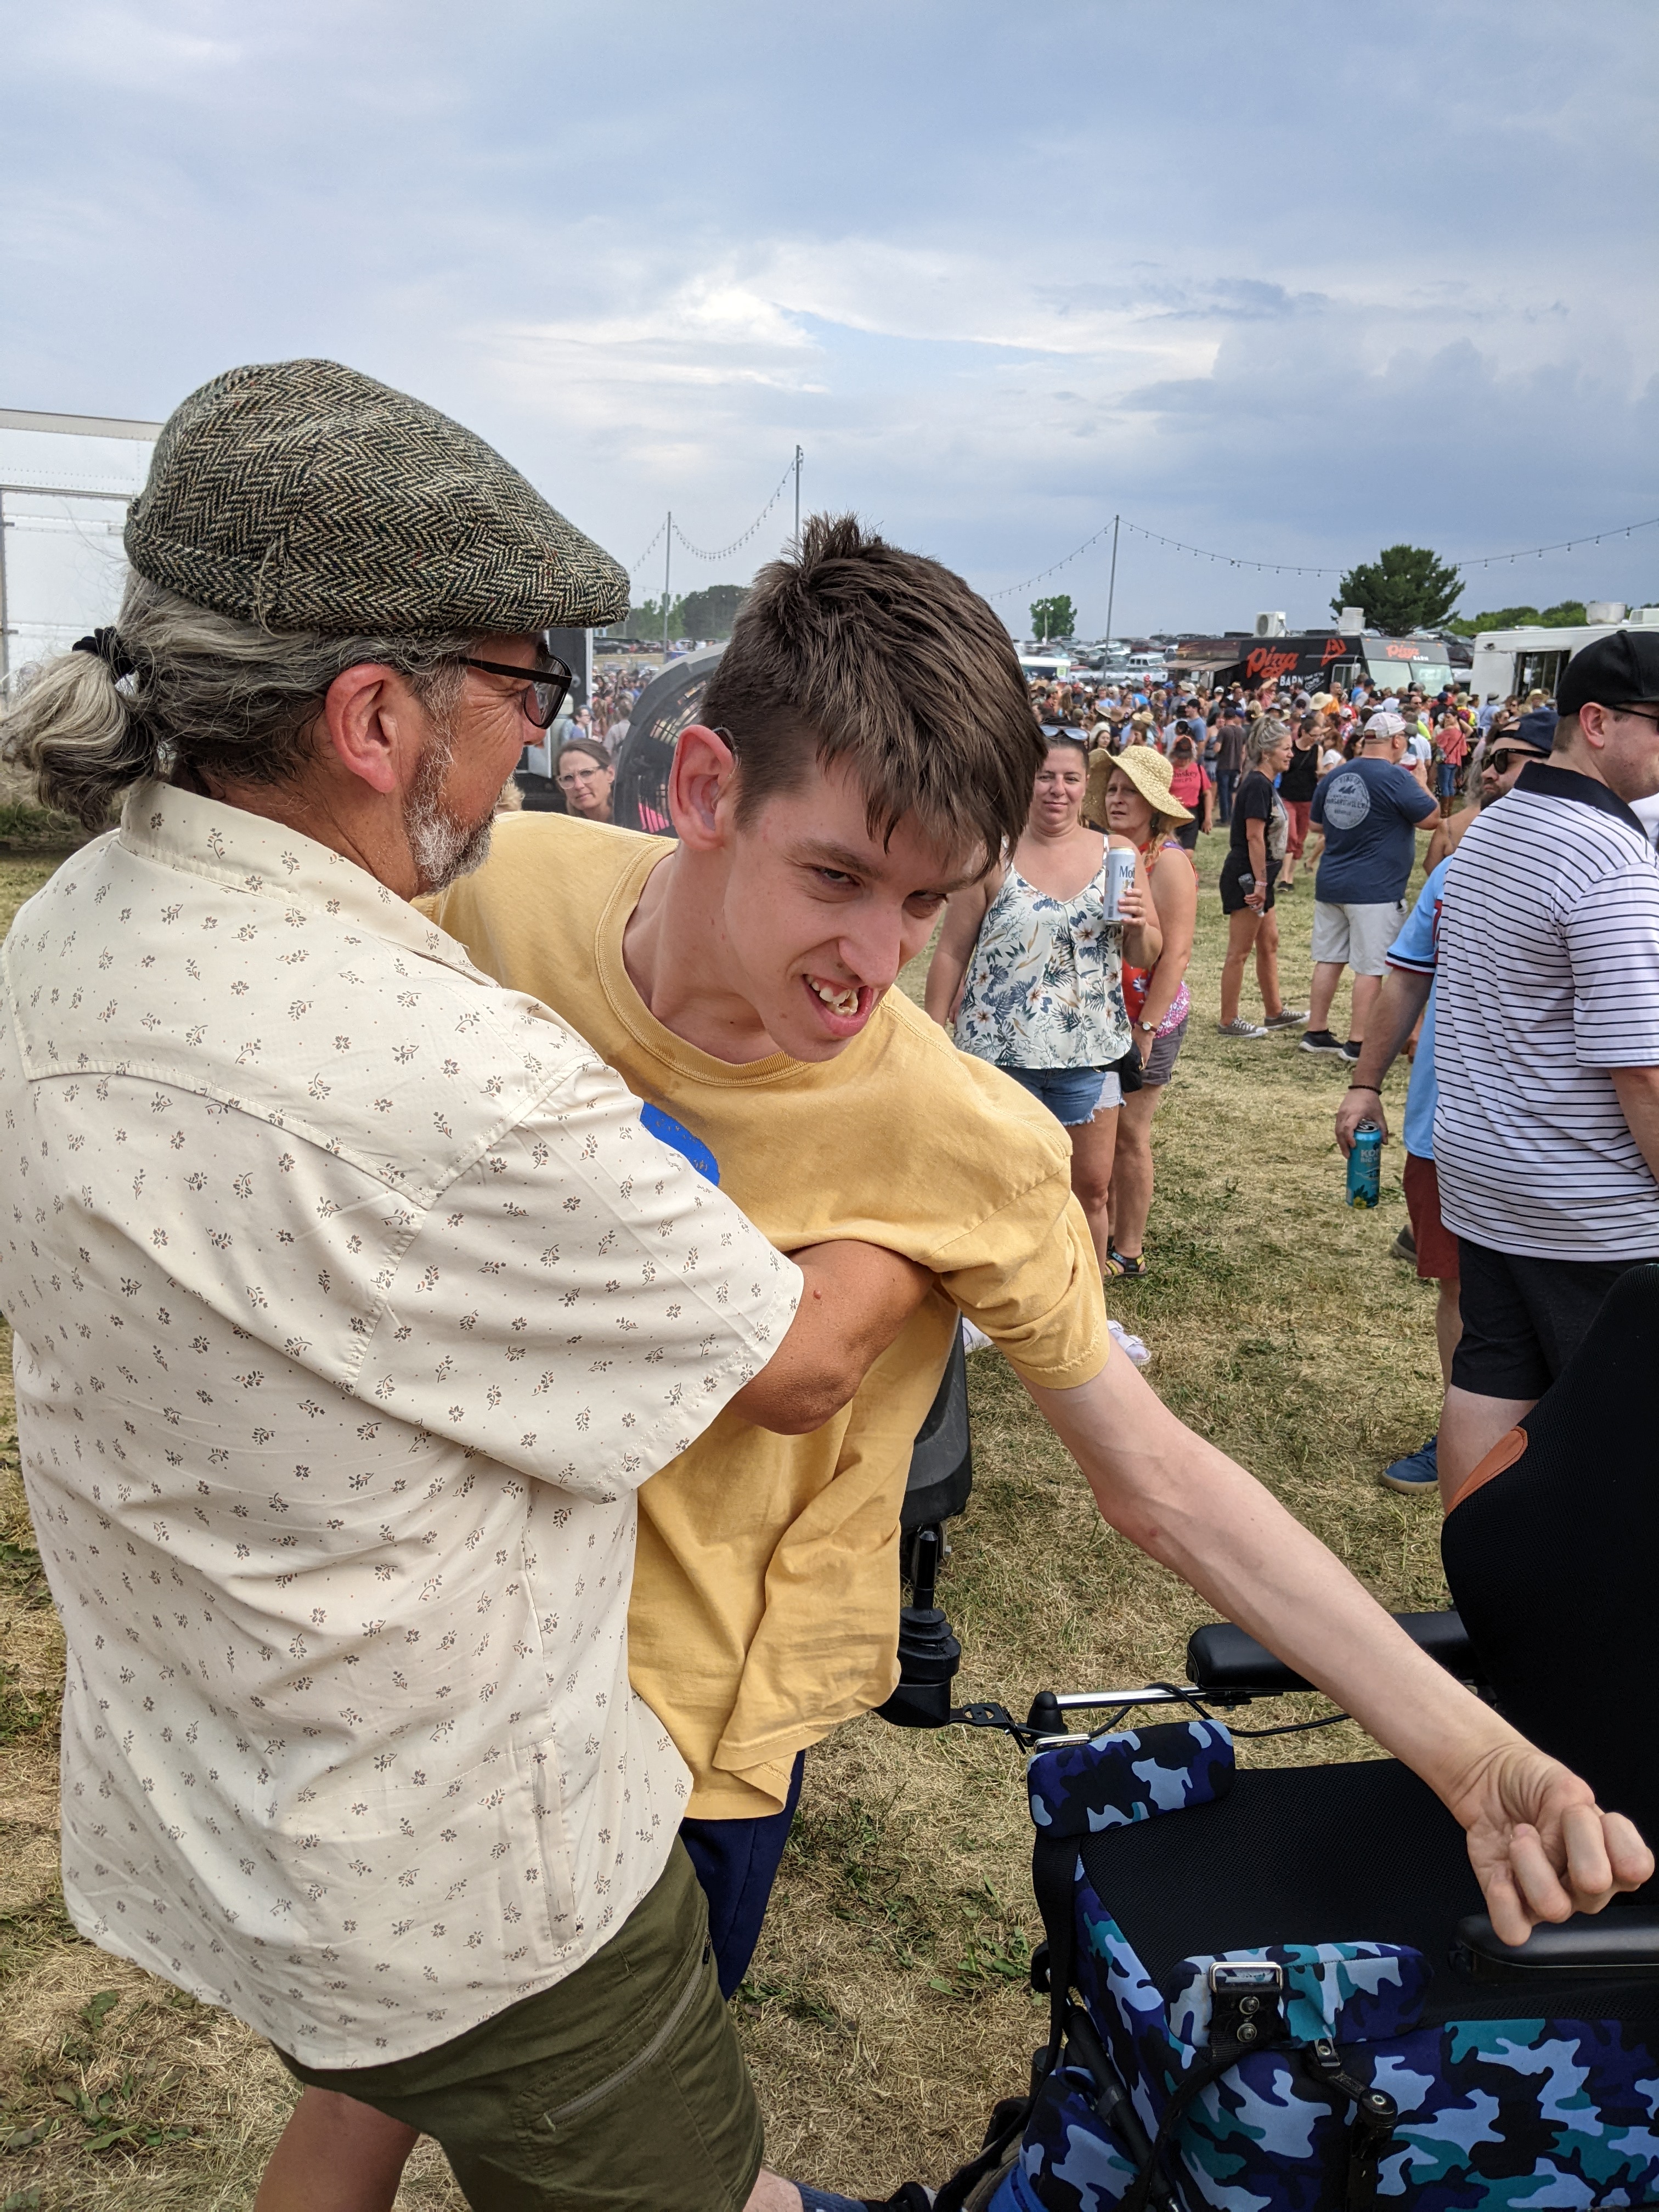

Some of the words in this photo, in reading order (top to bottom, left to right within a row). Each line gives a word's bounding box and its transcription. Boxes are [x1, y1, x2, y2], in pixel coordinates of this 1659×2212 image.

[1386, 645, 1420, 659] Pizza
[1246, 646, 1299, 679] Pizza
[1279, 675, 1304, 686] BARN
